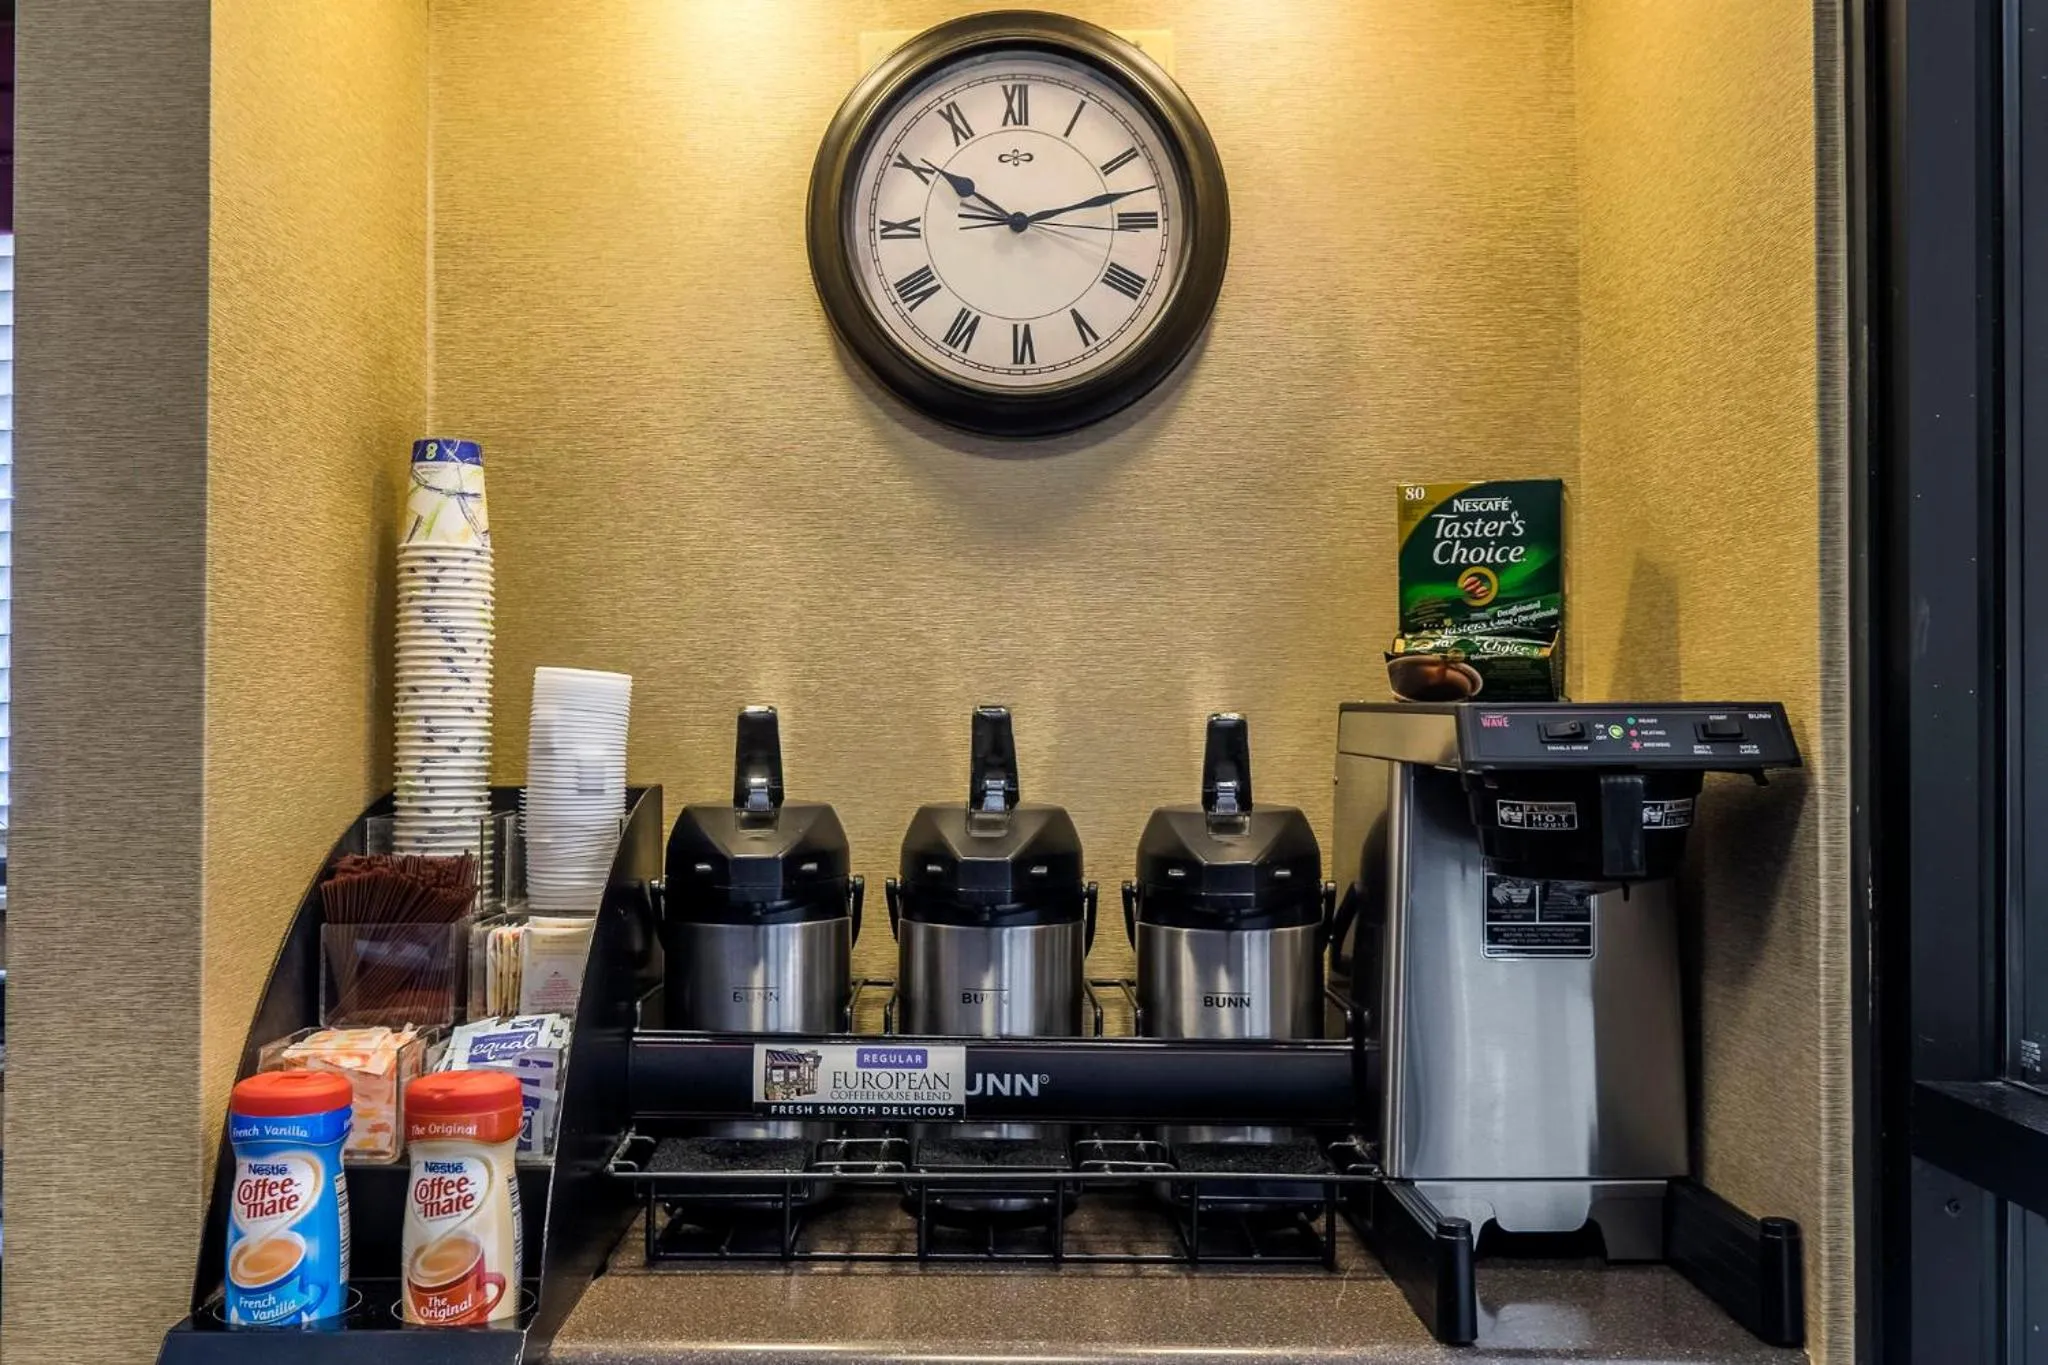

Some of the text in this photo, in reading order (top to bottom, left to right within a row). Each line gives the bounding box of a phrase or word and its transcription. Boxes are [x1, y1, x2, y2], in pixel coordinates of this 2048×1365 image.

[1002, 84, 1029, 126] XII
[937, 100, 976, 147] XI
[1063, 100, 1086, 138] I
[1100, 147, 1139, 176] II
[880, 216, 921, 240] IX
[1117, 211, 1158, 230] III
[893, 265, 941, 312] VIII
[942, 308, 981, 354] VII
[1070, 308, 1100, 348] V
[1012, 324, 1036, 365] VI
[1405, 487, 1425, 501] 80
[1453, 497, 1512, 512] NESCAFÉ
[1432, 510, 1525, 539] Taster's
[1433, 540, 1525, 565] Choice
[1481, 716, 1510, 728] WAVE
[1532, 814, 1567, 823] HOT
[1203, 996, 1250, 1008] BUNN
[470, 1033, 536, 1060] equal
[863, 1054, 923, 1063] REGULAR
[832, 1071, 950, 1090] EUROPEAN
[965, 1072, 1039, 1096] UNN
[830, 1091, 953, 1101] COFFEEHOUSE BLEND
[771, 1105, 955, 1116] FRESH SMOOTH DELICIOUS
[264, 1124, 309, 1138] Vanilla
[411, 1123, 478, 1137] The Original
[246, 1194, 300, 1219] mate
[423, 1193, 475, 1218] mate
[240, 1293, 277, 1309] French
[252, 1299, 297, 1321] Vanilla
[420, 1293, 472, 1322] Original
[428, 1296, 448, 1307] The
